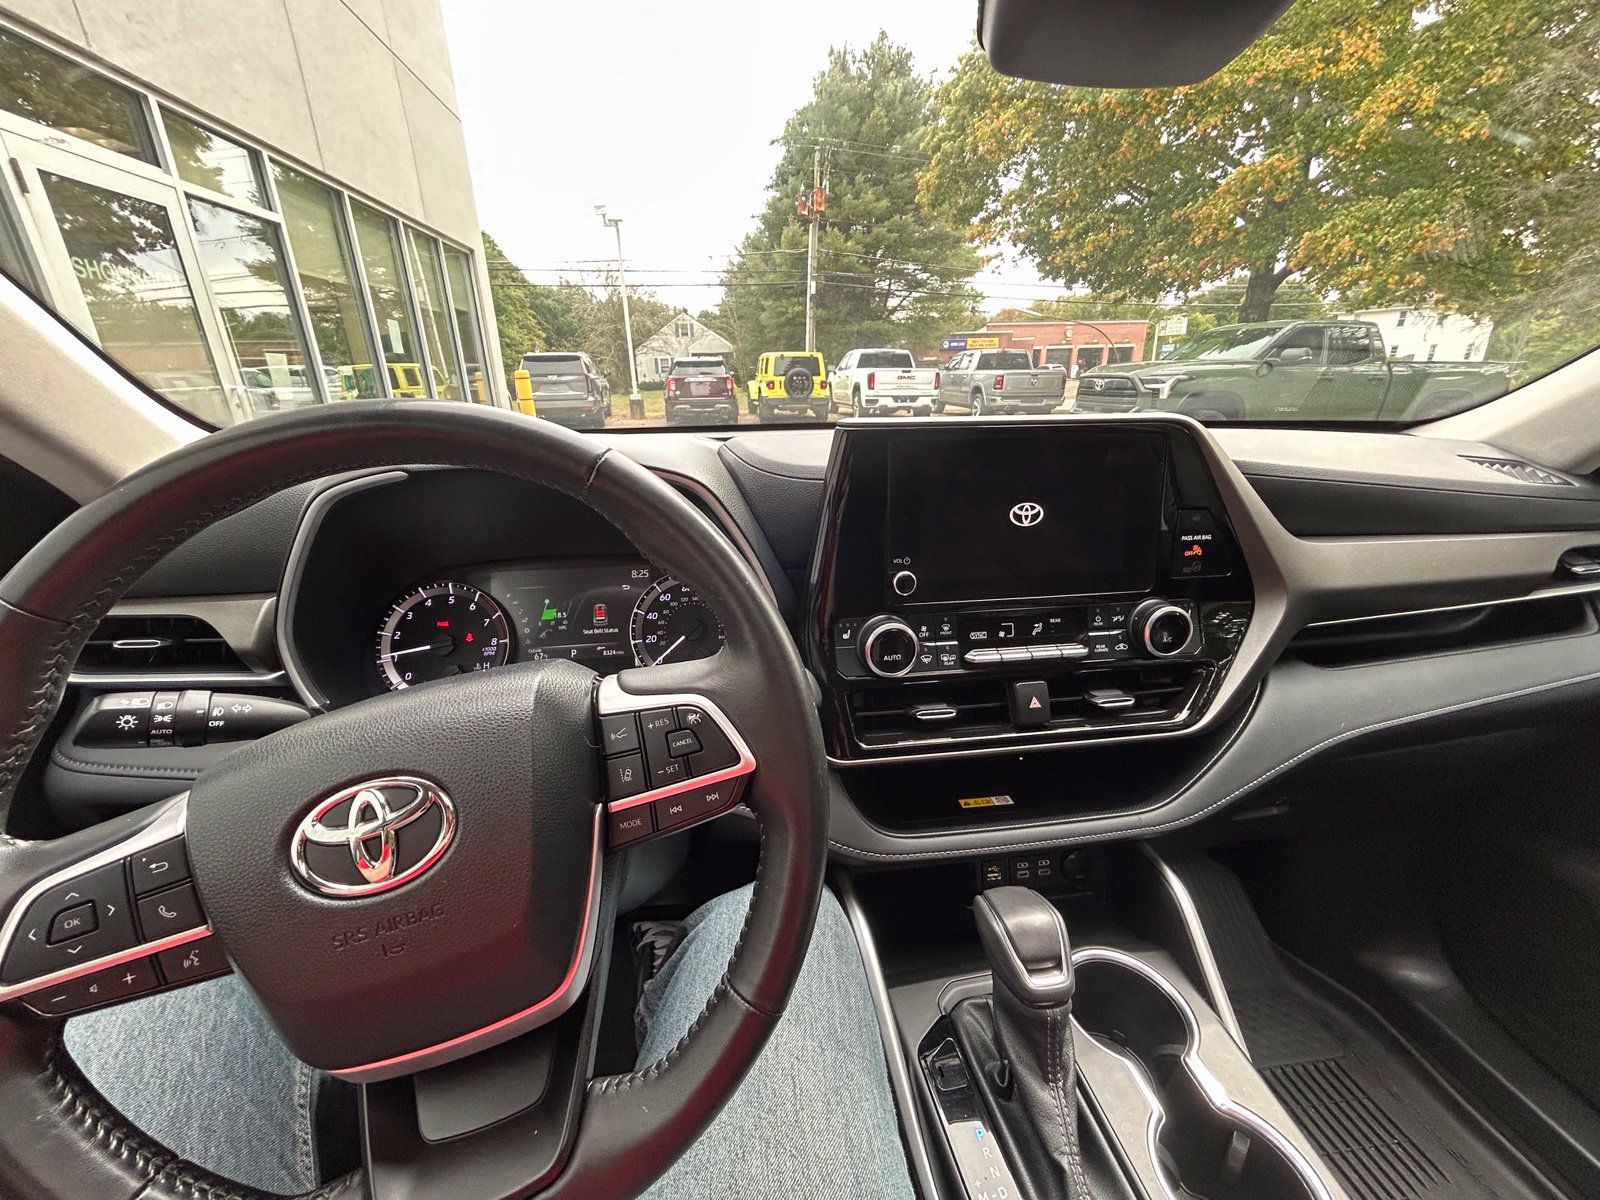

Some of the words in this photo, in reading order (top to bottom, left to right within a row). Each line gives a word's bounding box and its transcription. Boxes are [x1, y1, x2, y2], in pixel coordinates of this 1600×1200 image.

[631, 570, 649, 578] 8:25
[448, 596, 455, 604] 5
[660, 593, 671, 601] 60
[470, 603, 476, 611] 6
[647, 612, 658, 620] 40
[484, 619, 490, 627] 7
[394, 632, 401, 640] 2
[645, 635, 657, 643] 20
[405, 672, 412, 680] 0
[672, 738, 692, 747] CANCEL
[620, 819, 642, 830] MODE
[64, 918, 81, 929] OK
[332, 928, 367, 950] SRS
[376, 904, 444, 937] AIRBAG
[976, 1129, 983, 1141] P
[982, 1147, 993, 1159] R
[990, 1166, 1000, 1178] N
